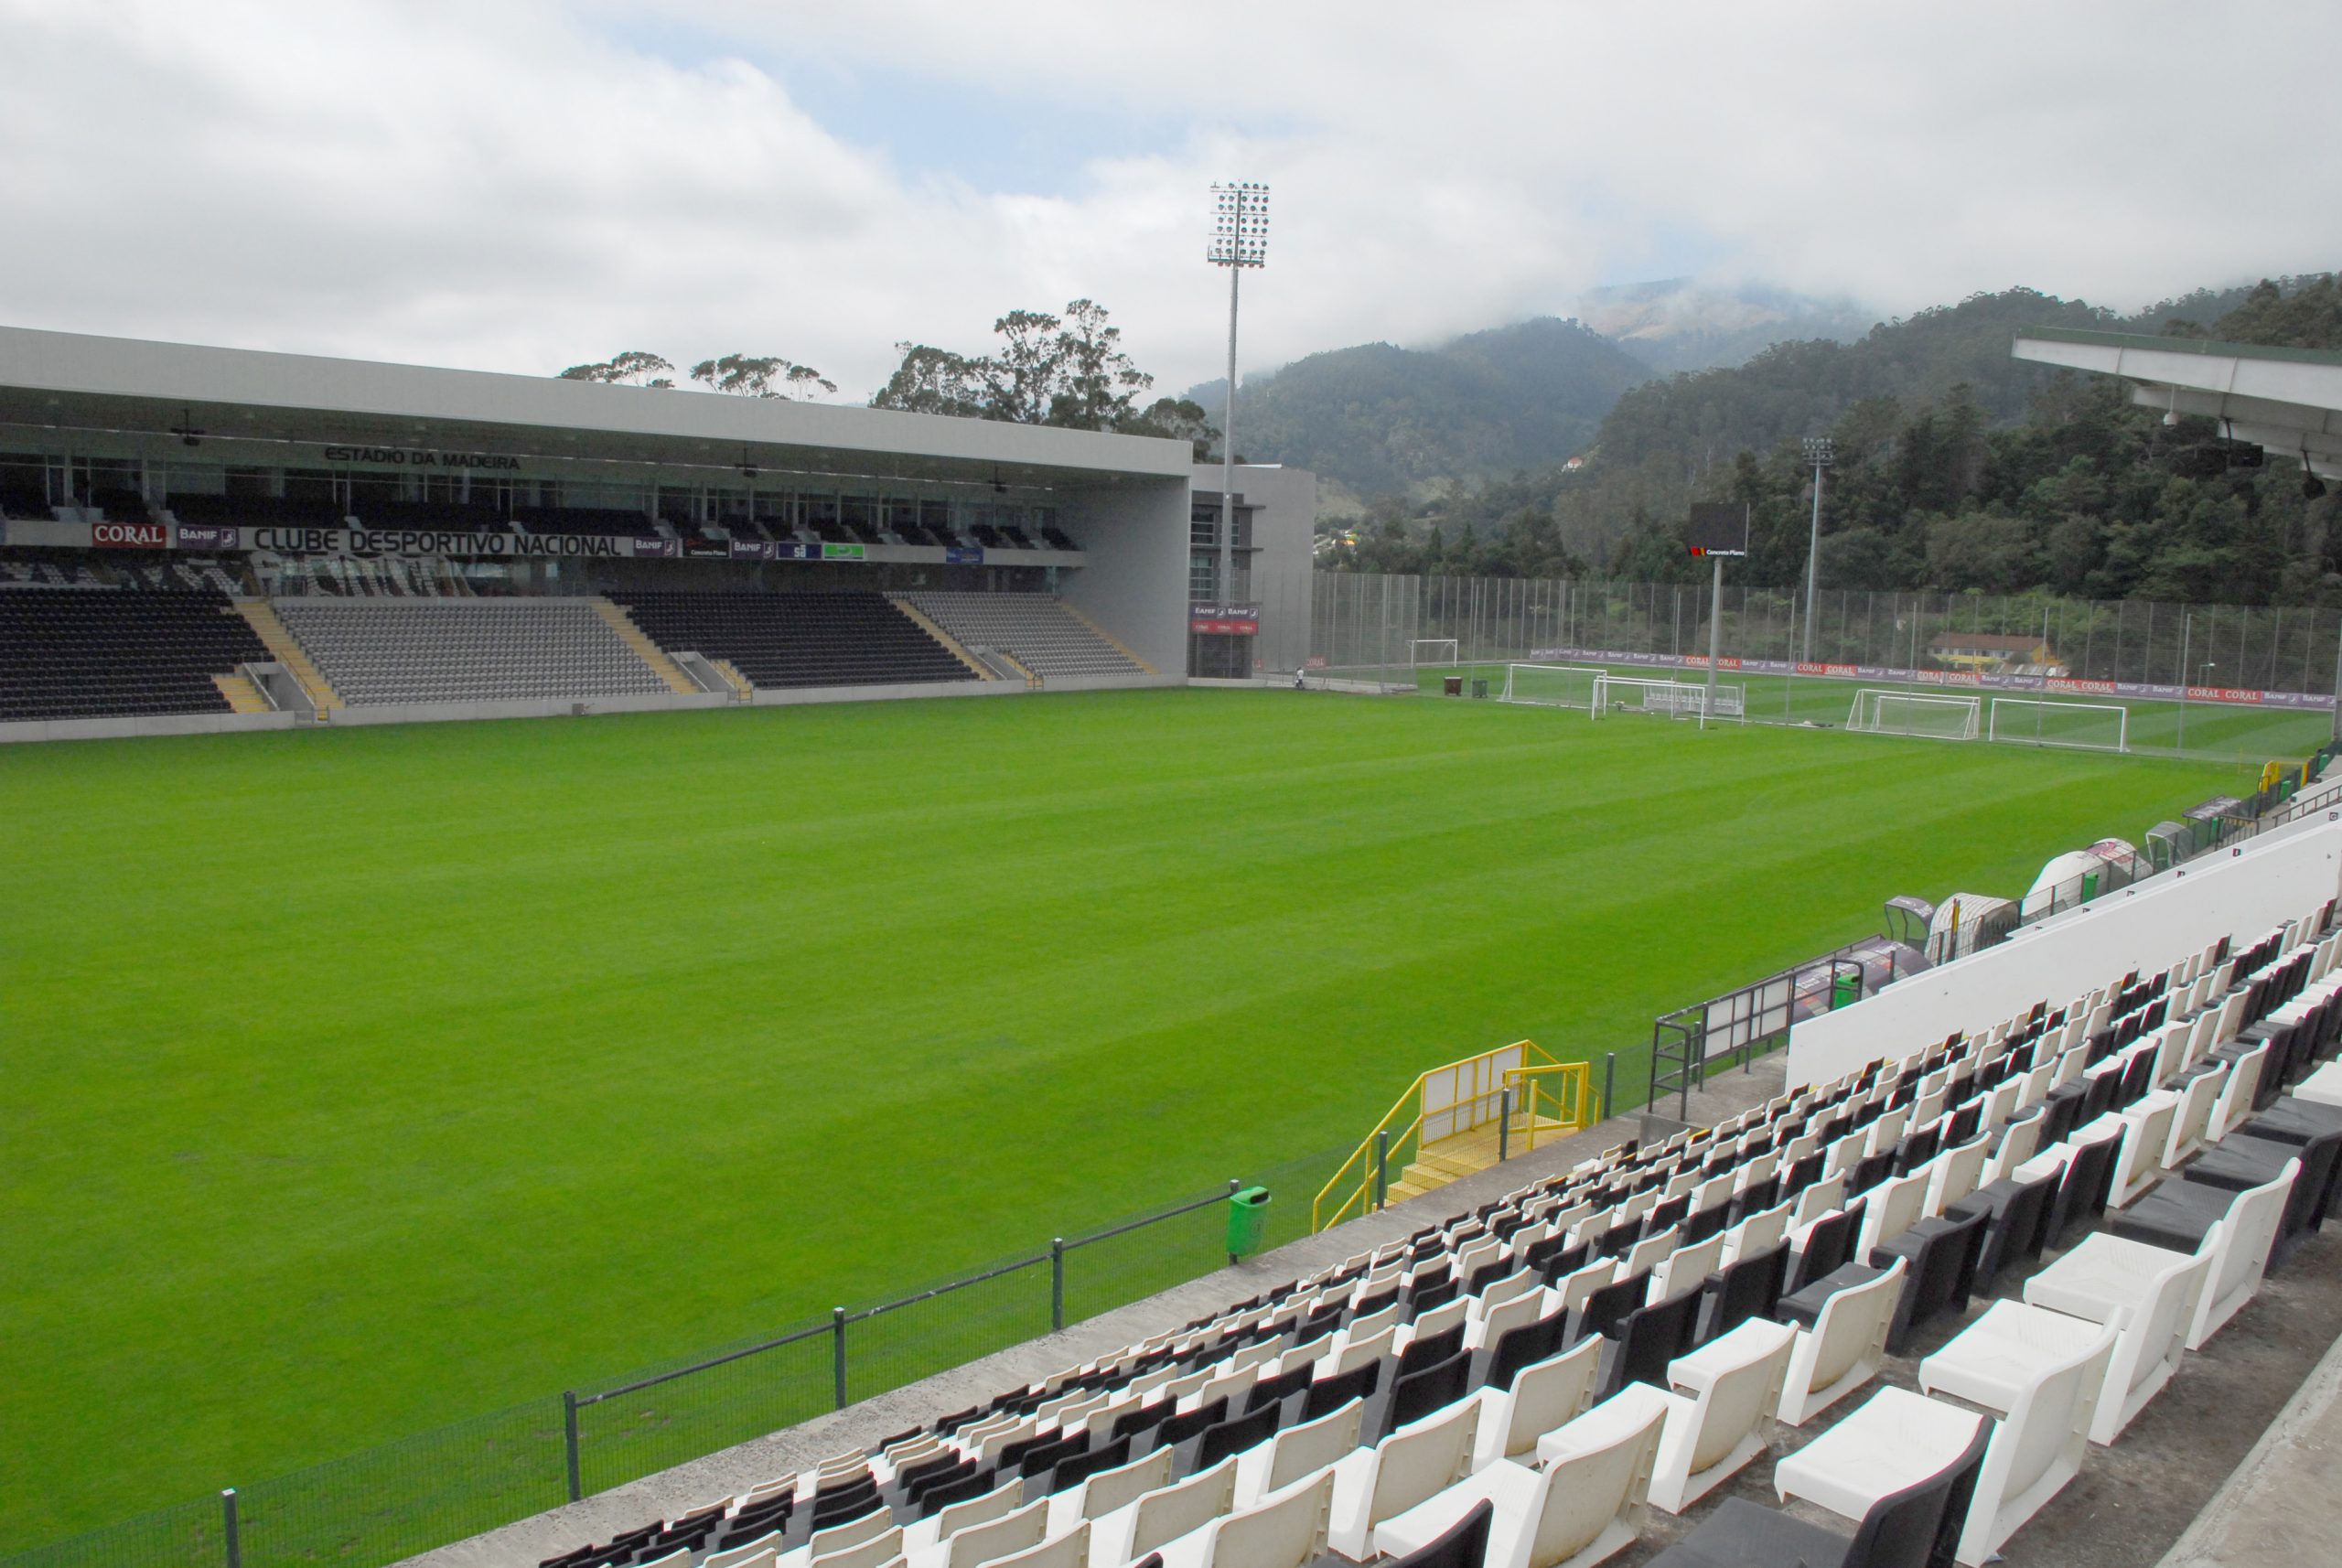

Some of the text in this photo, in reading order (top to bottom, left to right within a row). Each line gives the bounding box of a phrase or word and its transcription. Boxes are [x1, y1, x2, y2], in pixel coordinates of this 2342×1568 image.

[411, 452, 436, 466] DA
[443, 454, 520, 470] MADEIRA
[94, 525, 163, 544] CORAL
[179, 528, 218, 540] BANIF
[254, 528, 621, 555] CLUBE DESPORTIVO NACIONAL
[636, 540, 662, 549] BANIF
[734, 542, 761, 552] BANIF
[1798, 663, 1823, 672] CORAL
[1827, 665, 1853, 674] CORAL
[1950, 673, 1976, 682] CORAL
[2047, 679, 2077, 689] CORAL
[2081, 682, 2111, 691] CORAL
[2188, 688, 2218, 698] CORAL
[2225, 690, 2258, 700] CORAL
